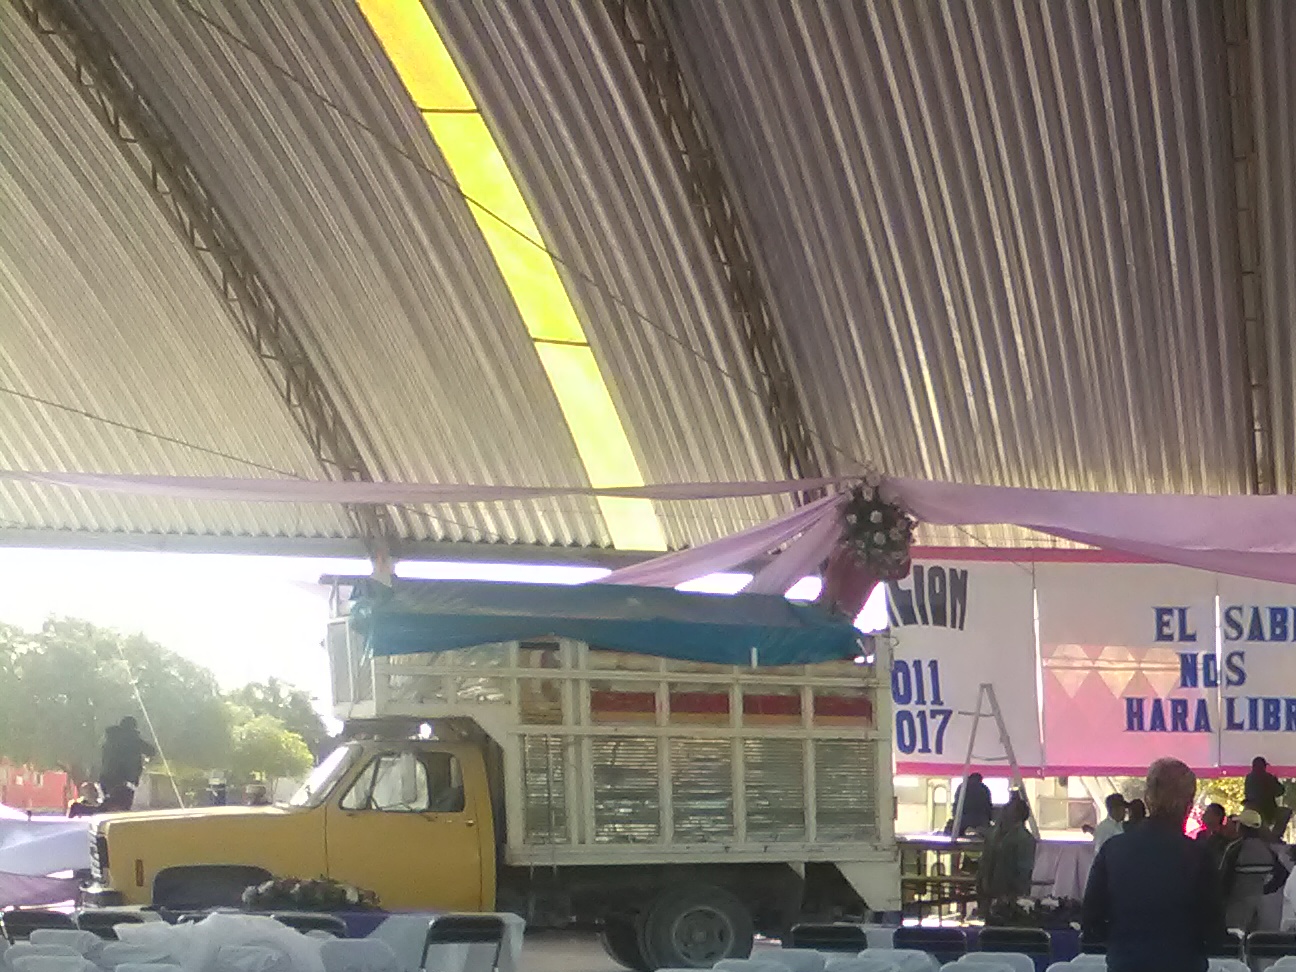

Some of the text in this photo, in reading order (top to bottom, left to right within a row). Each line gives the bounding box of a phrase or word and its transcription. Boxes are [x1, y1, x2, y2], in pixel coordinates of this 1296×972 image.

[1152, 605, 1197, 642] EL
[1177, 651, 1246, 689] NOS
[895, 709, 953, 755] 017
[1124, 697, 1212, 733] HARA
